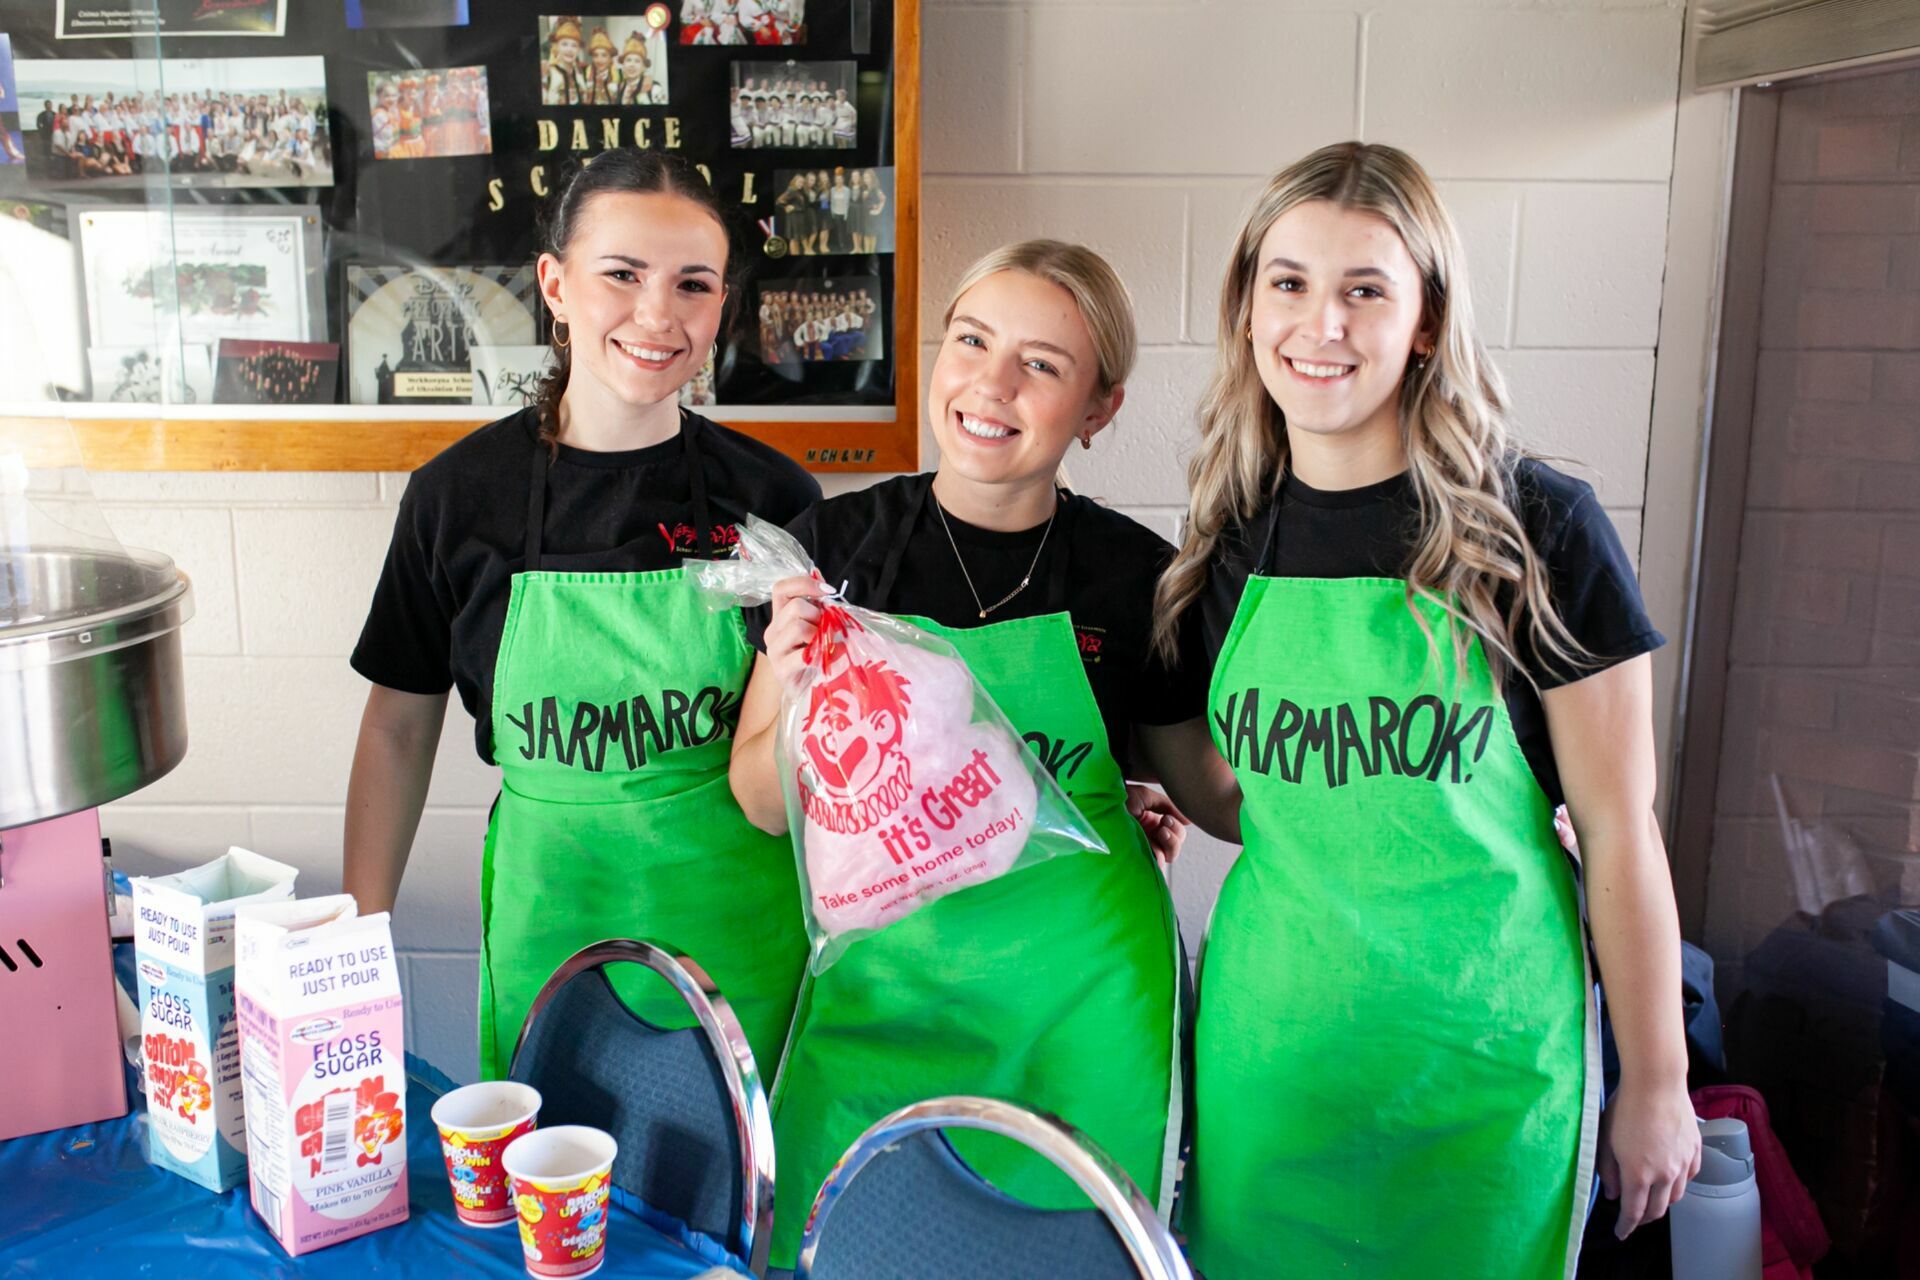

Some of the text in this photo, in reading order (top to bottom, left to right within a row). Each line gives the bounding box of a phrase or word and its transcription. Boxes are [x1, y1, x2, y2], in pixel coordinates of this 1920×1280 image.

[537, 117, 683, 151] DANCE
[1214, 688, 1494, 789] YARMAROK!
[920, 748, 1002, 831] Great
[818, 807, 1024, 911] Take some home today!
[140, 906, 168, 927] READY
[169, 917, 180, 933] TO
[181, 922, 197, 940] USE
[148, 926, 190, 956] JUST POUR
[289, 945, 388, 979] READY TO USE
[303, 967, 380, 997] JUST POUR
[150, 985, 191, 1014] FLOSS
[343, 1006, 372, 1019] Ready
[374, 1003, 383, 1012] to
[151, 1002, 193, 1032] SUGAR
[145, 1033, 195, 1067] COTTON
[313, 1030, 381, 1061] FLOSS
[314, 1048, 383, 1079] SUGAR
[464, 1156, 491, 1167] WIN
[310, 1200, 338, 1213] Makes
[352, 1192, 361, 1200] to
[362, 1189, 373, 1197] 70
[374, 1181, 399, 1194] Cones
[316, 1168, 392, 1198] PINK VANILLA
